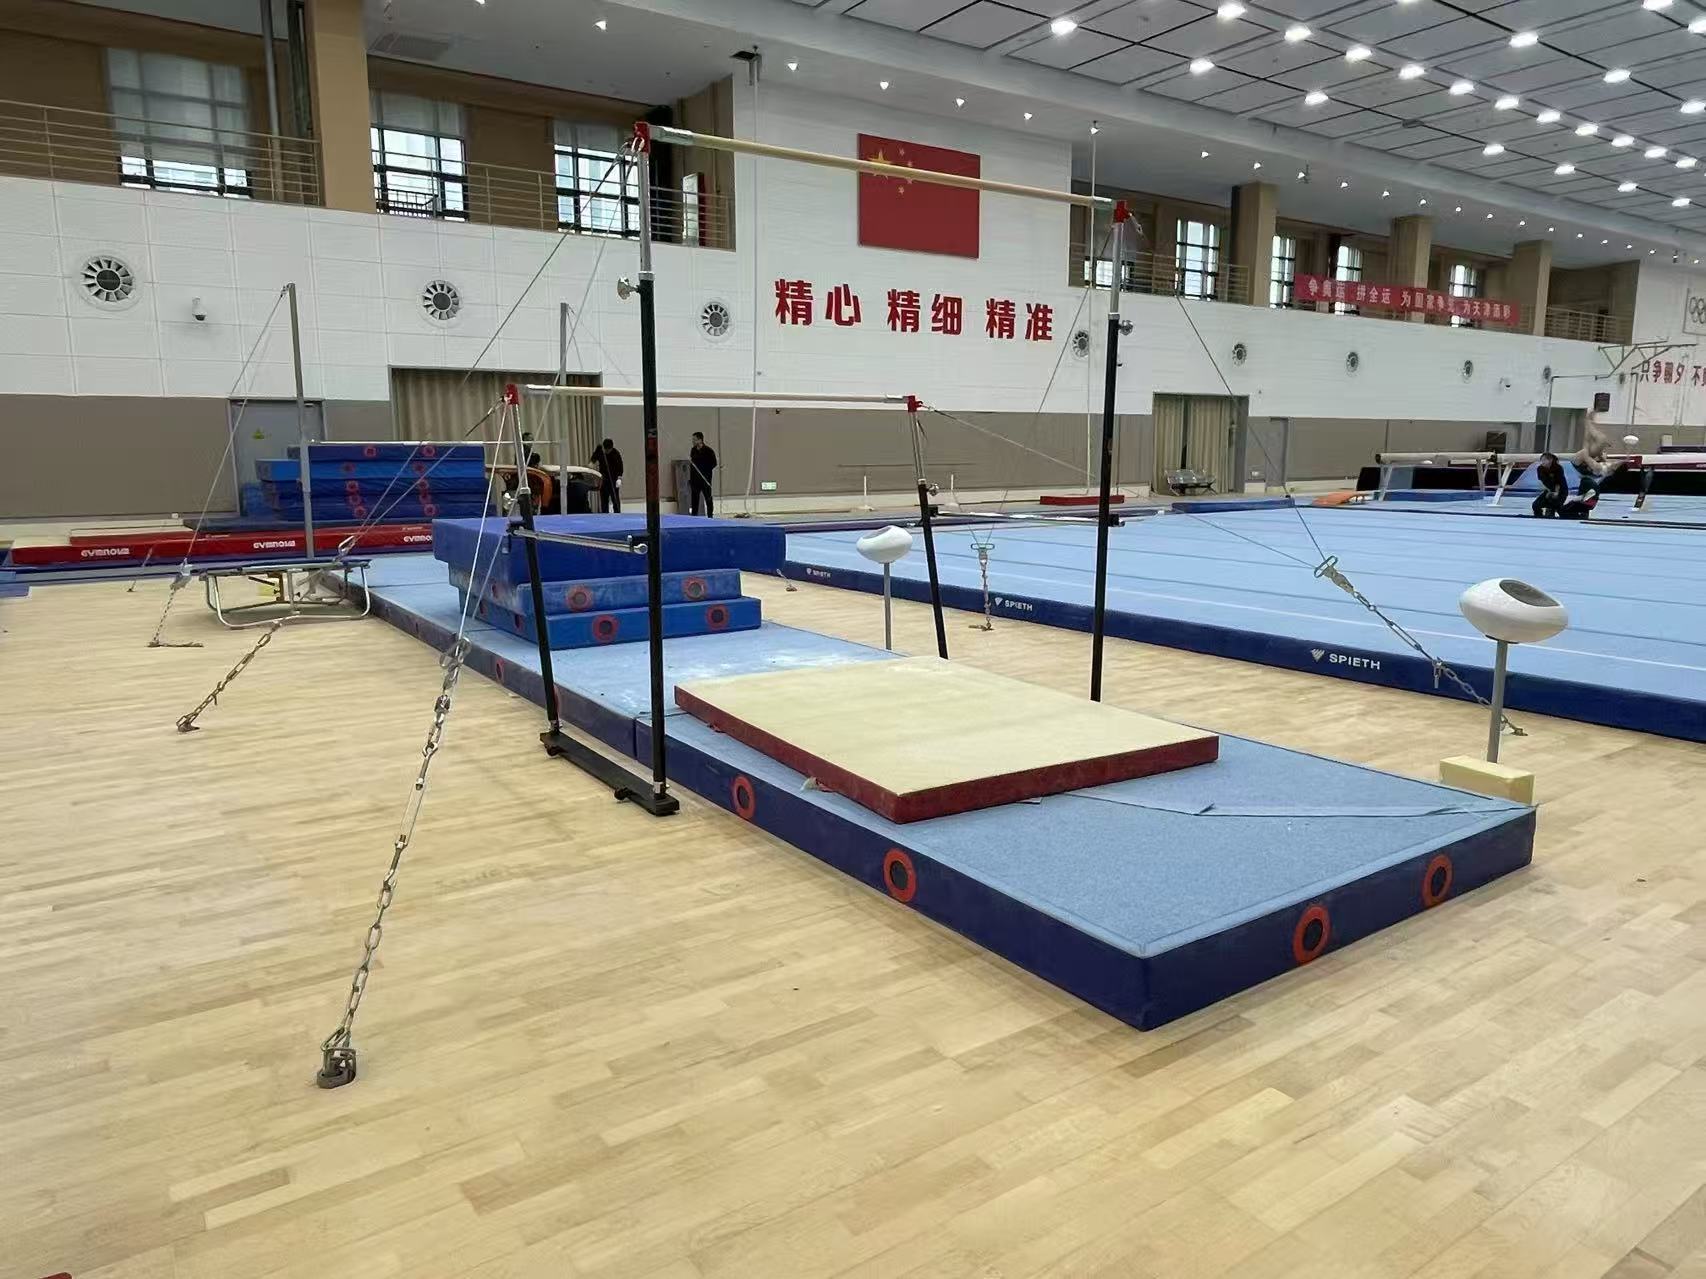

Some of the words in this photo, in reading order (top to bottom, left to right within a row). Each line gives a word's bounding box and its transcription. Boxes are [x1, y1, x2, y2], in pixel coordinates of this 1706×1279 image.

[774, 278, 862, 327] 精心
[887, 288, 963, 336] 精细
[985, 297, 1053, 342] 精准
[1004, 599, 1033, 611] SPIETH
[1328, 653, 1380, 670] SPIETH
